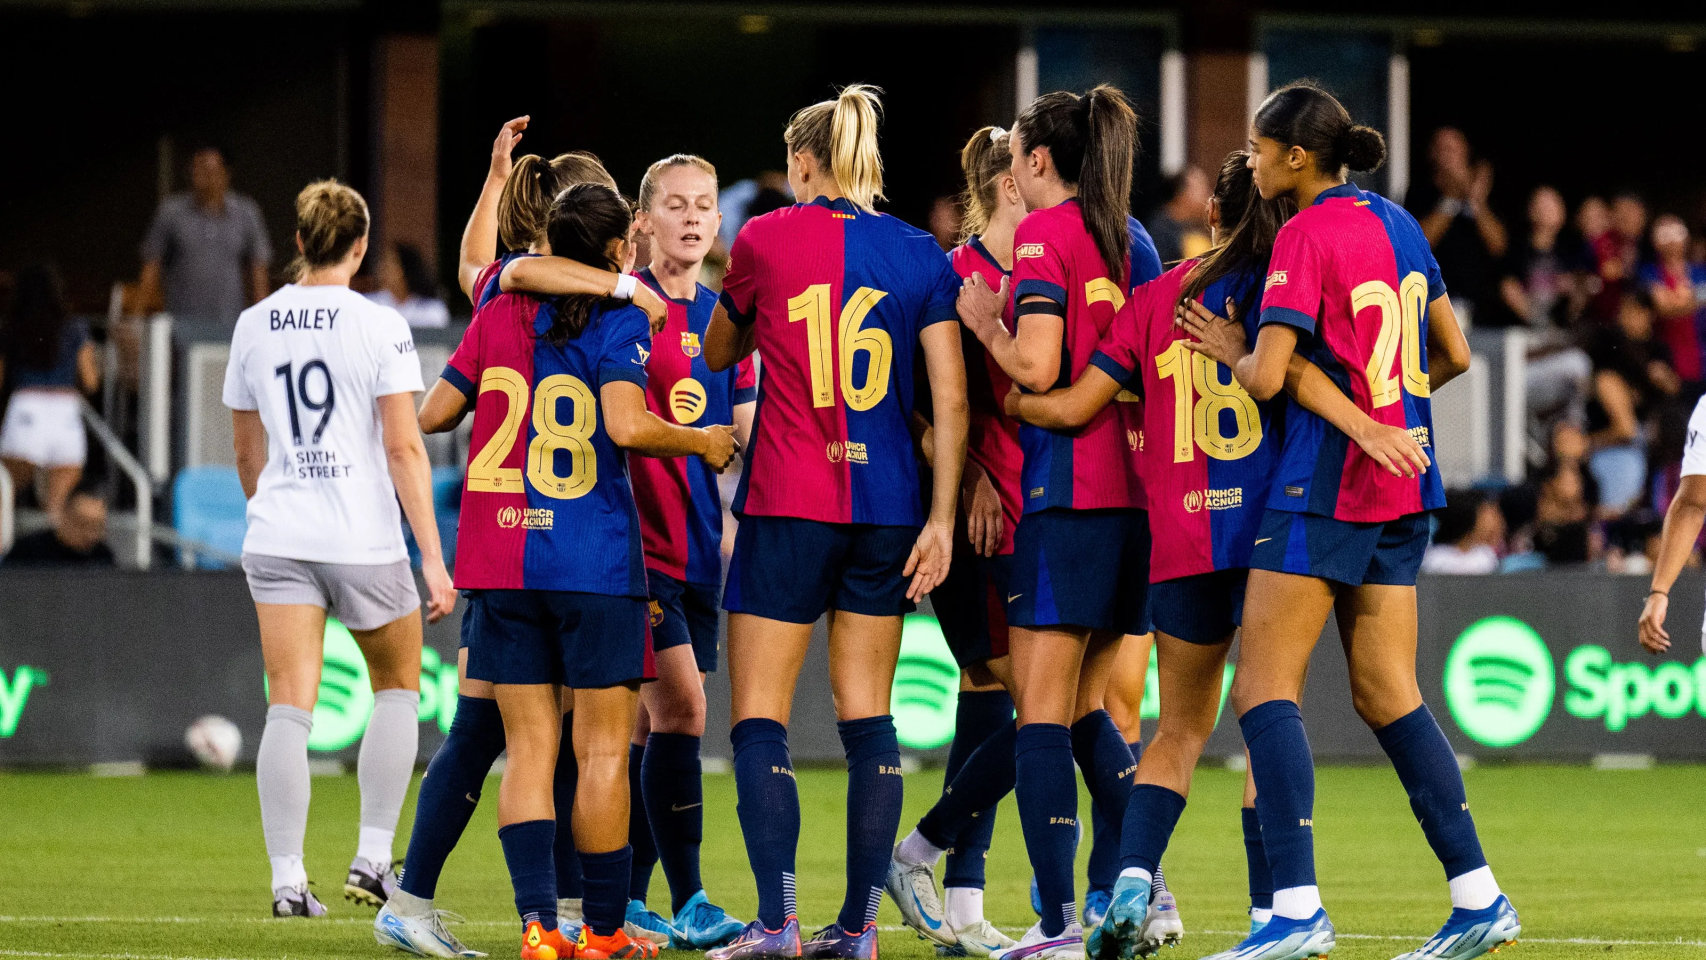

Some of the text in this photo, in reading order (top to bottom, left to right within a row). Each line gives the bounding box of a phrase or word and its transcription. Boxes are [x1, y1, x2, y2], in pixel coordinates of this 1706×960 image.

[270, 308, 340, 331] BAILEY
[394, 340, 416, 355] VIS
[787, 283, 893, 412] 16
[1351, 271, 1431, 409] 20
[274, 358, 336, 446] 19
[1155, 339, 1263, 463] 18
[467, 366, 597, 500] 28
[296, 451, 336, 464] SIXTH
[298, 465, 352, 479] STREET
[1204, 487, 1242, 498] UNHCR
[1204, 495, 1242, 507] ACNUR
[523, 508, 554, 518] UNHCR
[521, 517, 553, 526] ACNUR
